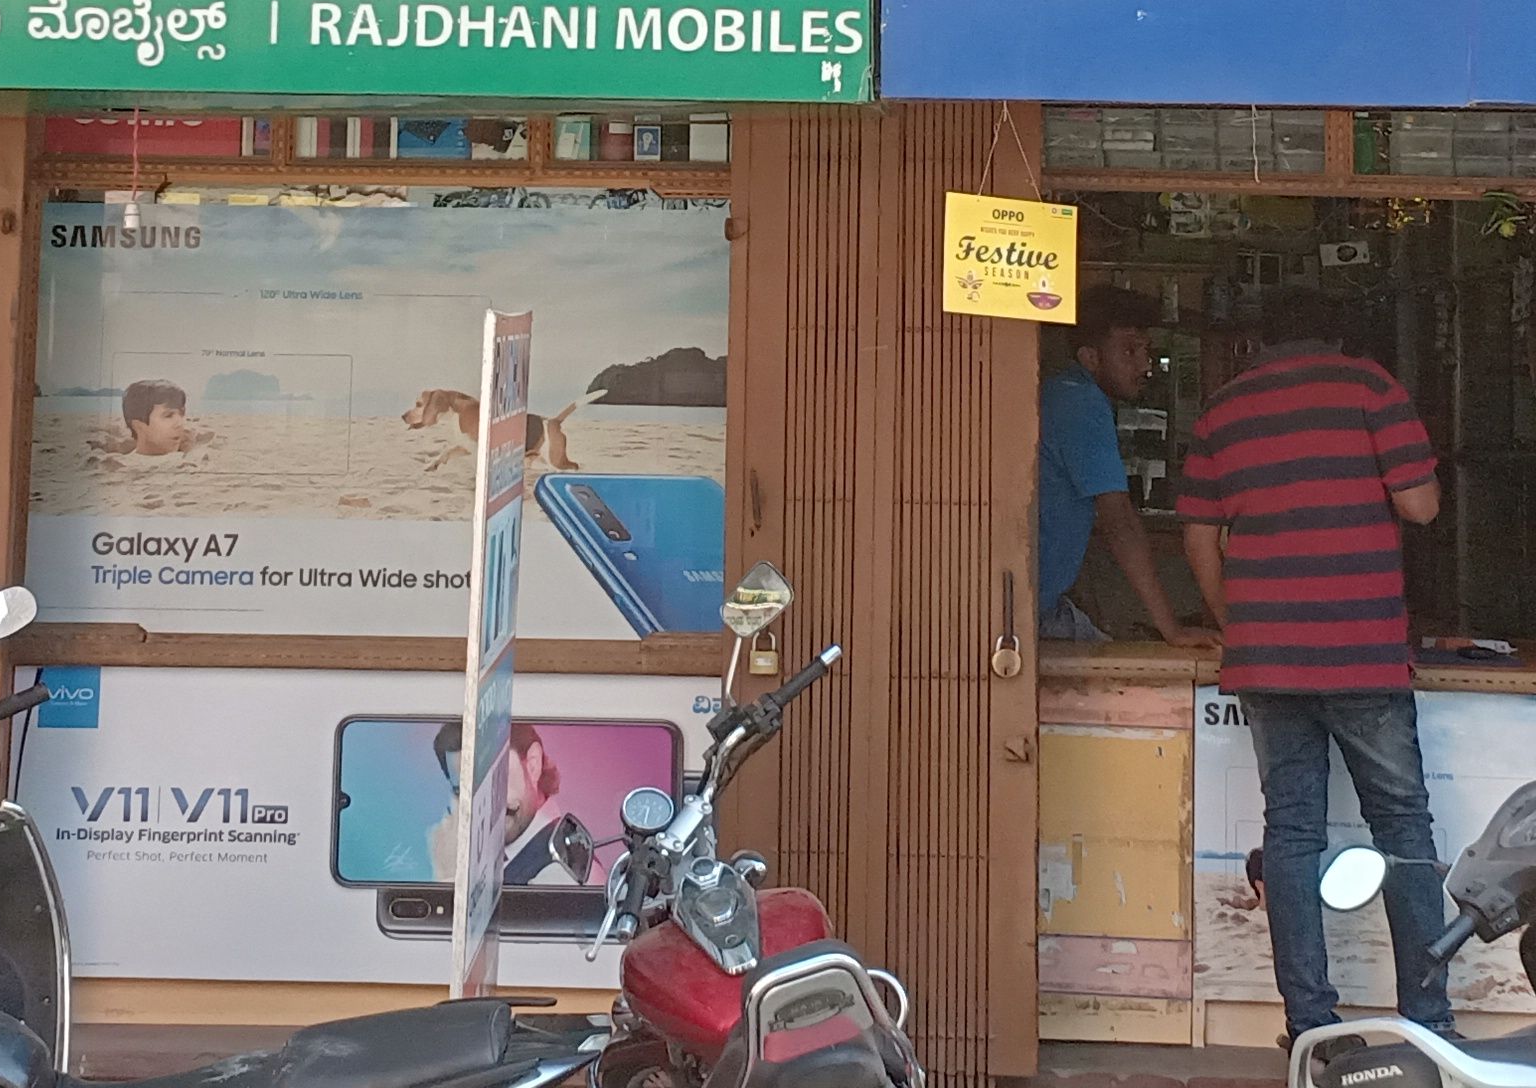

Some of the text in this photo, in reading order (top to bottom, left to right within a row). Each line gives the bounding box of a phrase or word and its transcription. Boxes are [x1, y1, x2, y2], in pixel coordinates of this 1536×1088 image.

[310, 3, 599, 52] RAJDHANI
[616, 6, 864, 58] MOBILES
[992, 208, 1024, 223] OPPO
[50, 223, 202, 251] SAMSUNG
[955, 235, 1059, 270] Festive
[984, 266, 1030, 281] SEASON
[92, 531, 239, 563] Galaxy A7
[91, 564, 472, 590] Triple Camera for Ultra Wide shot
[47, 685, 94, 700] vivo
[71, 786, 287, 824] V11 V11 Pro
[56, 827, 134, 844] In-Display
[138, 828, 224, 845] Fingerprint
[87, 849, 131, 863] Perfect
[169, 850, 214, 864] Perfect
[217, 852, 268, 864] Moment
[1341, 1064, 1402, 1087] HONDA
